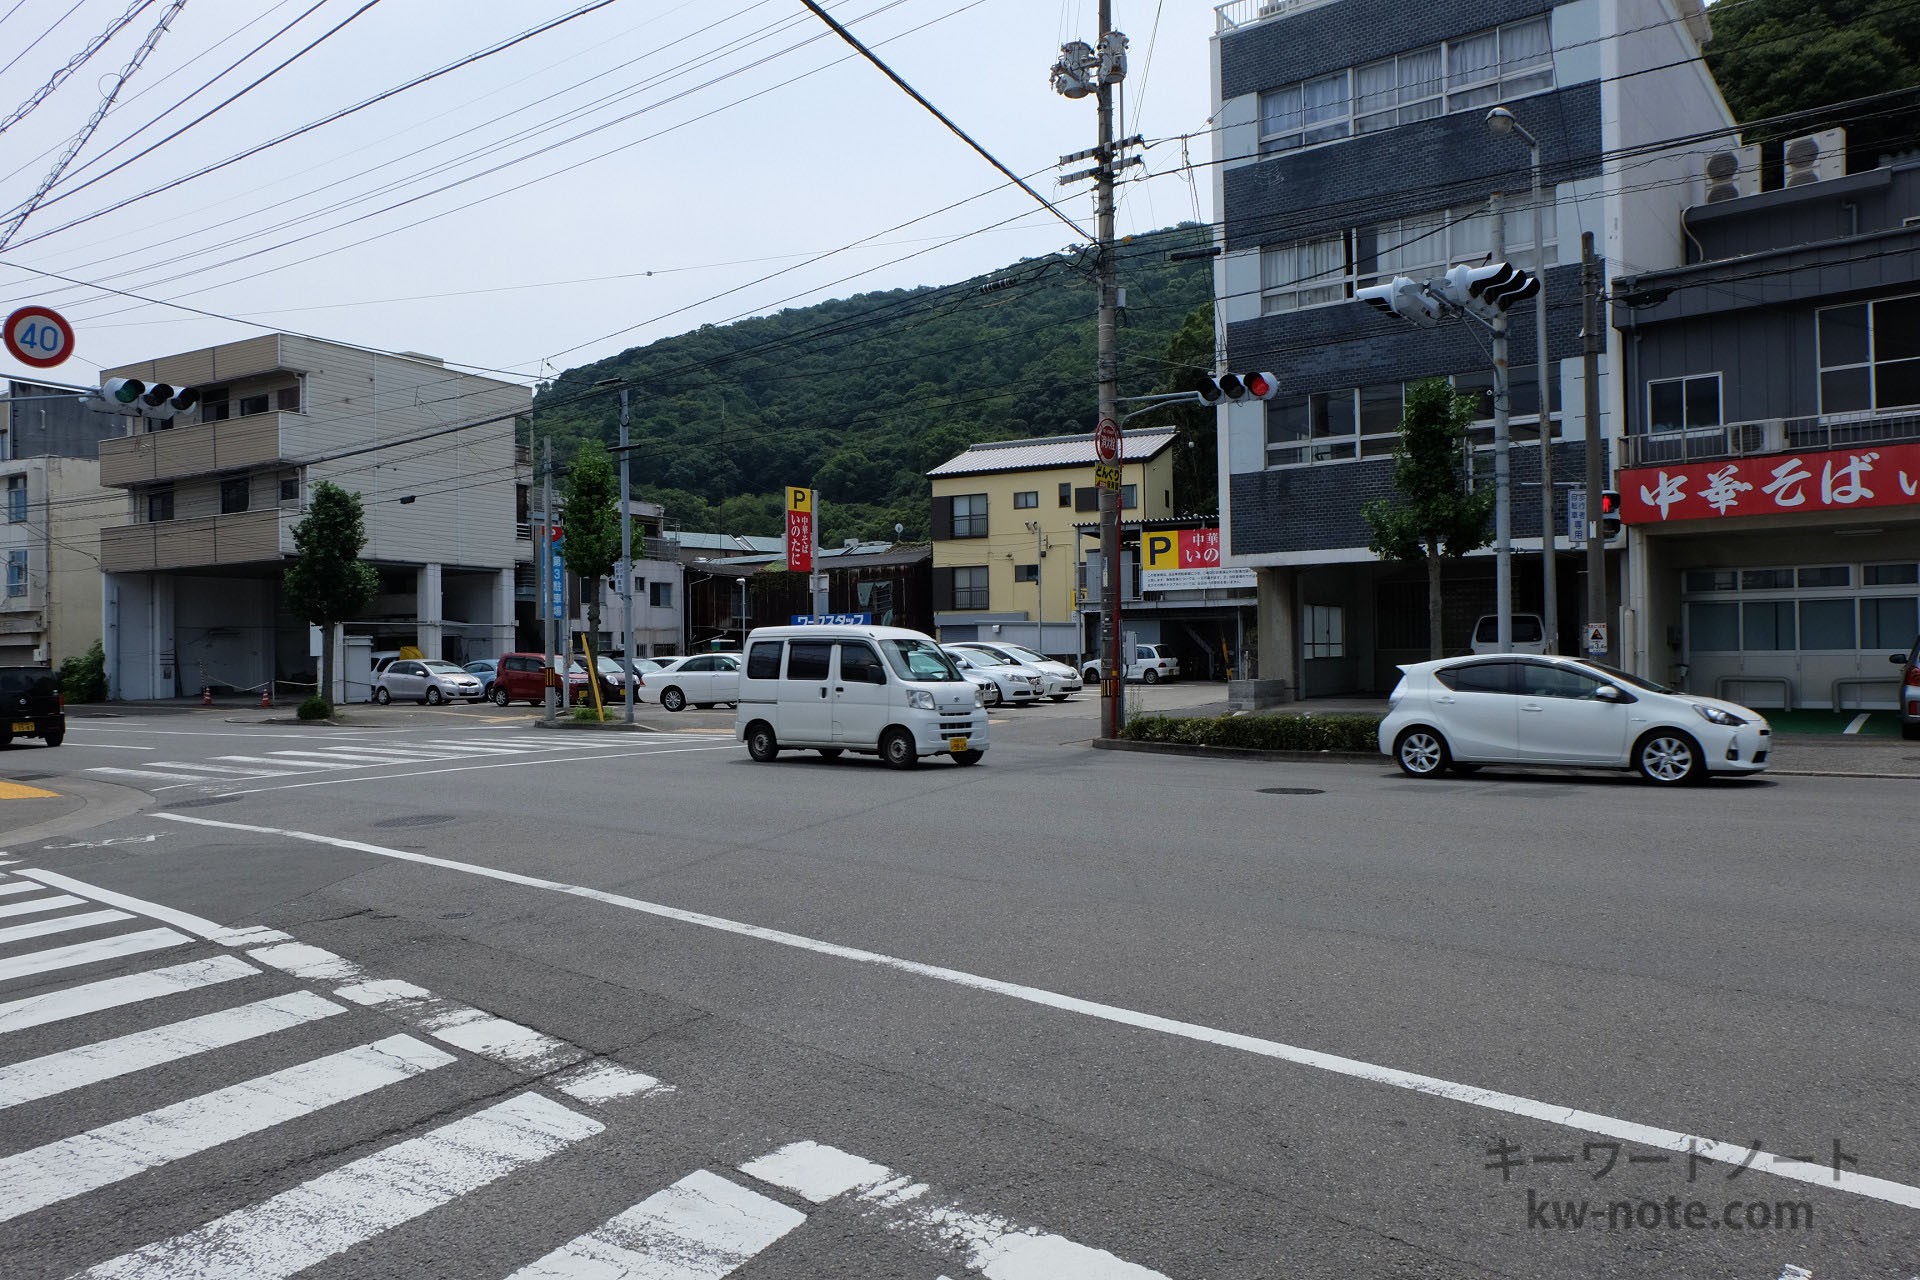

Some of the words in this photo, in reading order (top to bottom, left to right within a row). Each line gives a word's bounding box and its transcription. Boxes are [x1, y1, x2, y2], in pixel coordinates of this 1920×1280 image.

[20, 323, 58, 352] 40
[794, 490, 806, 509] P
[1640, 452, 1880, 520] 中華そば
[791, 514, 801, 566] いのたに
[1149, 537, 1172, 566] P
[1193, 532, 1219, 547] 中華
[1186, 548, 1219, 563] いの
